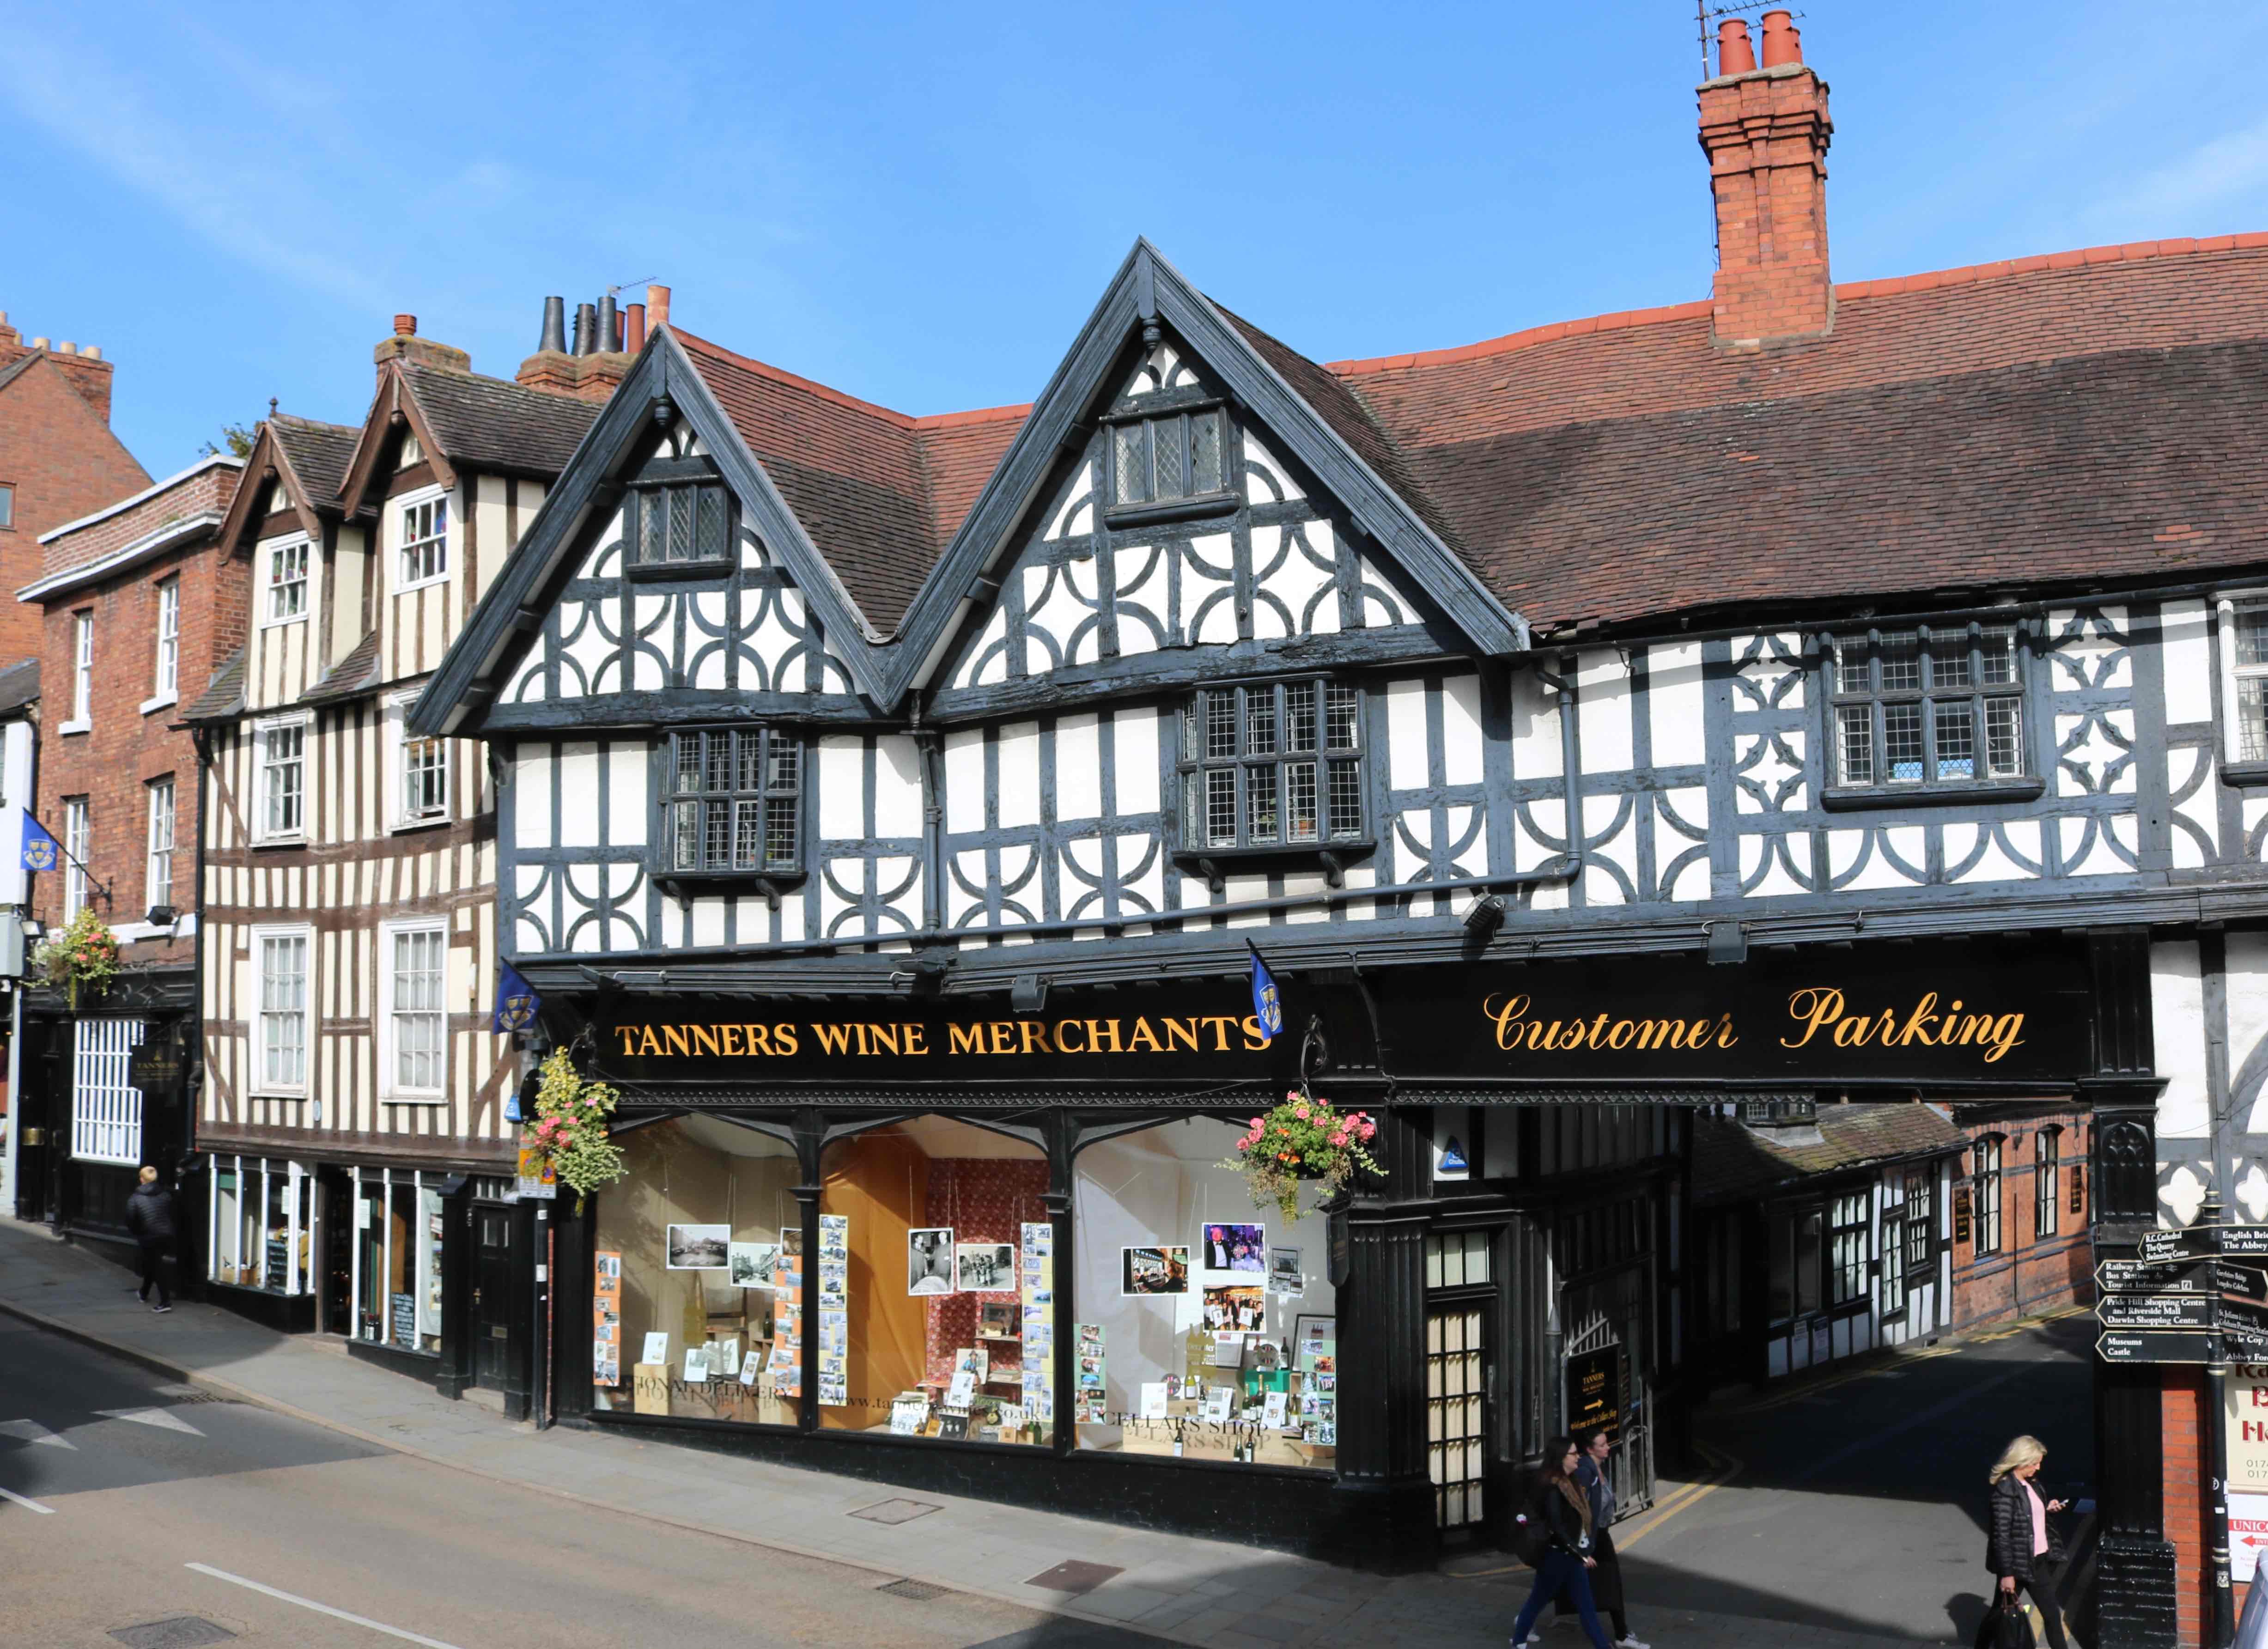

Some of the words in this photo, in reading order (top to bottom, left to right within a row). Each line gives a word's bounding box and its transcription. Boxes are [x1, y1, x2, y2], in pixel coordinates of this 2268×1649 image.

[1484, 992, 1738, 1050] Customer
[1780, 987, 2026, 1063] Parking
[615, 1023, 798, 1057] TANNERS
[811, 1023, 929, 1055] WINE
[946, 1016, 1272, 1054] MERCHANTS
[2157, 1231, 2182, 1241] Cathedral
[2223, 1231, 2252, 1241] English
[2146, 1244, 2156, 1252] The
[2157, 1242, 2175, 1252] Quarry
[2223, 1241, 2238, 1249] The
[2241, 1241, 2268, 1252] Abbey
[2146, 1252, 2172, 1261] Swimming
[2172, 1249, 2189, 1258] Centre
[2106, 1263, 2134, 1272] Railway
[2106, 1280, 2133, 1289] Tourist
[2135, 1281, 2180, 1289] Information
[2144, 1298, 2180, 1308] Shopping
[2136, 1316, 2171, 1326] Shopping
[2225, 1335, 2244, 1345] Wyle
[2247, 1335, 2263, 1345] Cop
[2225, 1352, 2251, 1362] Abbey
[700, 1381, 792, 1400] DELIVERY
[1106, 1411, 1201, 1433] CELLARS
[1209, 1418, 1269, 1436] SHOP
[2246, 1459, 2268, 1467] 017
[2232, 1520, 2268, 1531] UNIC
